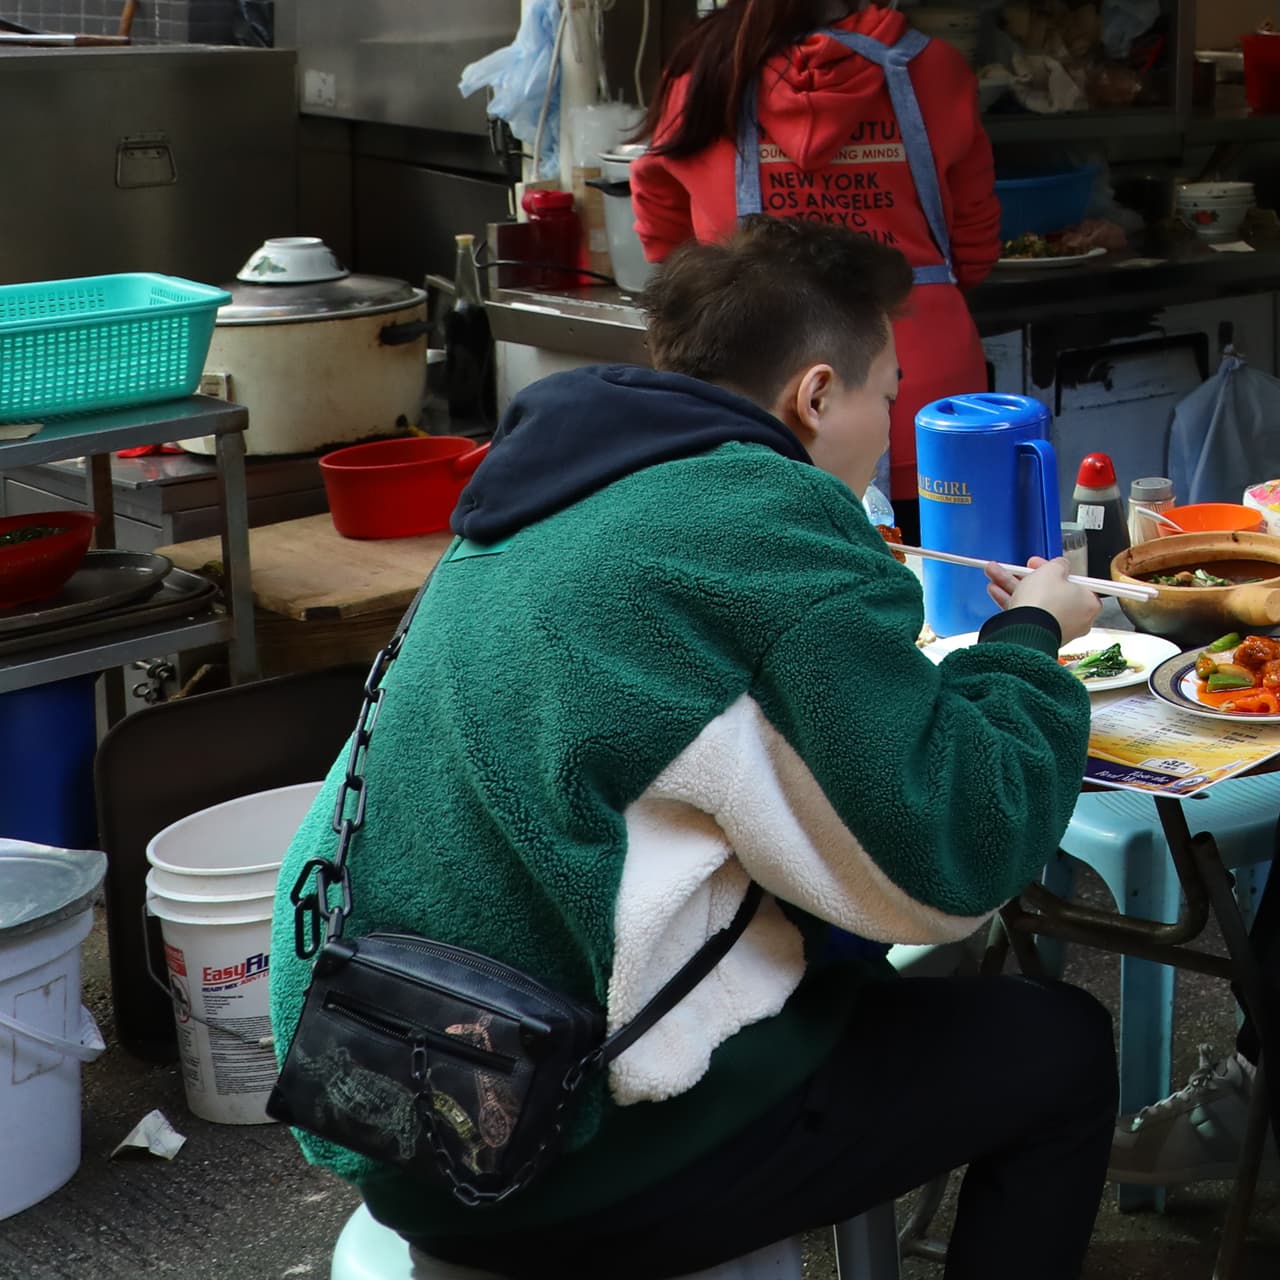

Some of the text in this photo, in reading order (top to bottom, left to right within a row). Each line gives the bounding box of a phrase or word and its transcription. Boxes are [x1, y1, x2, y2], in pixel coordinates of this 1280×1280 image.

[862, 148, 900, 159] MINDS
[769, 172, 880, 191] NEW YORK
[763, 191, 895, 210] OS ANGELES
[933, 479, 972, 496] GIRL
